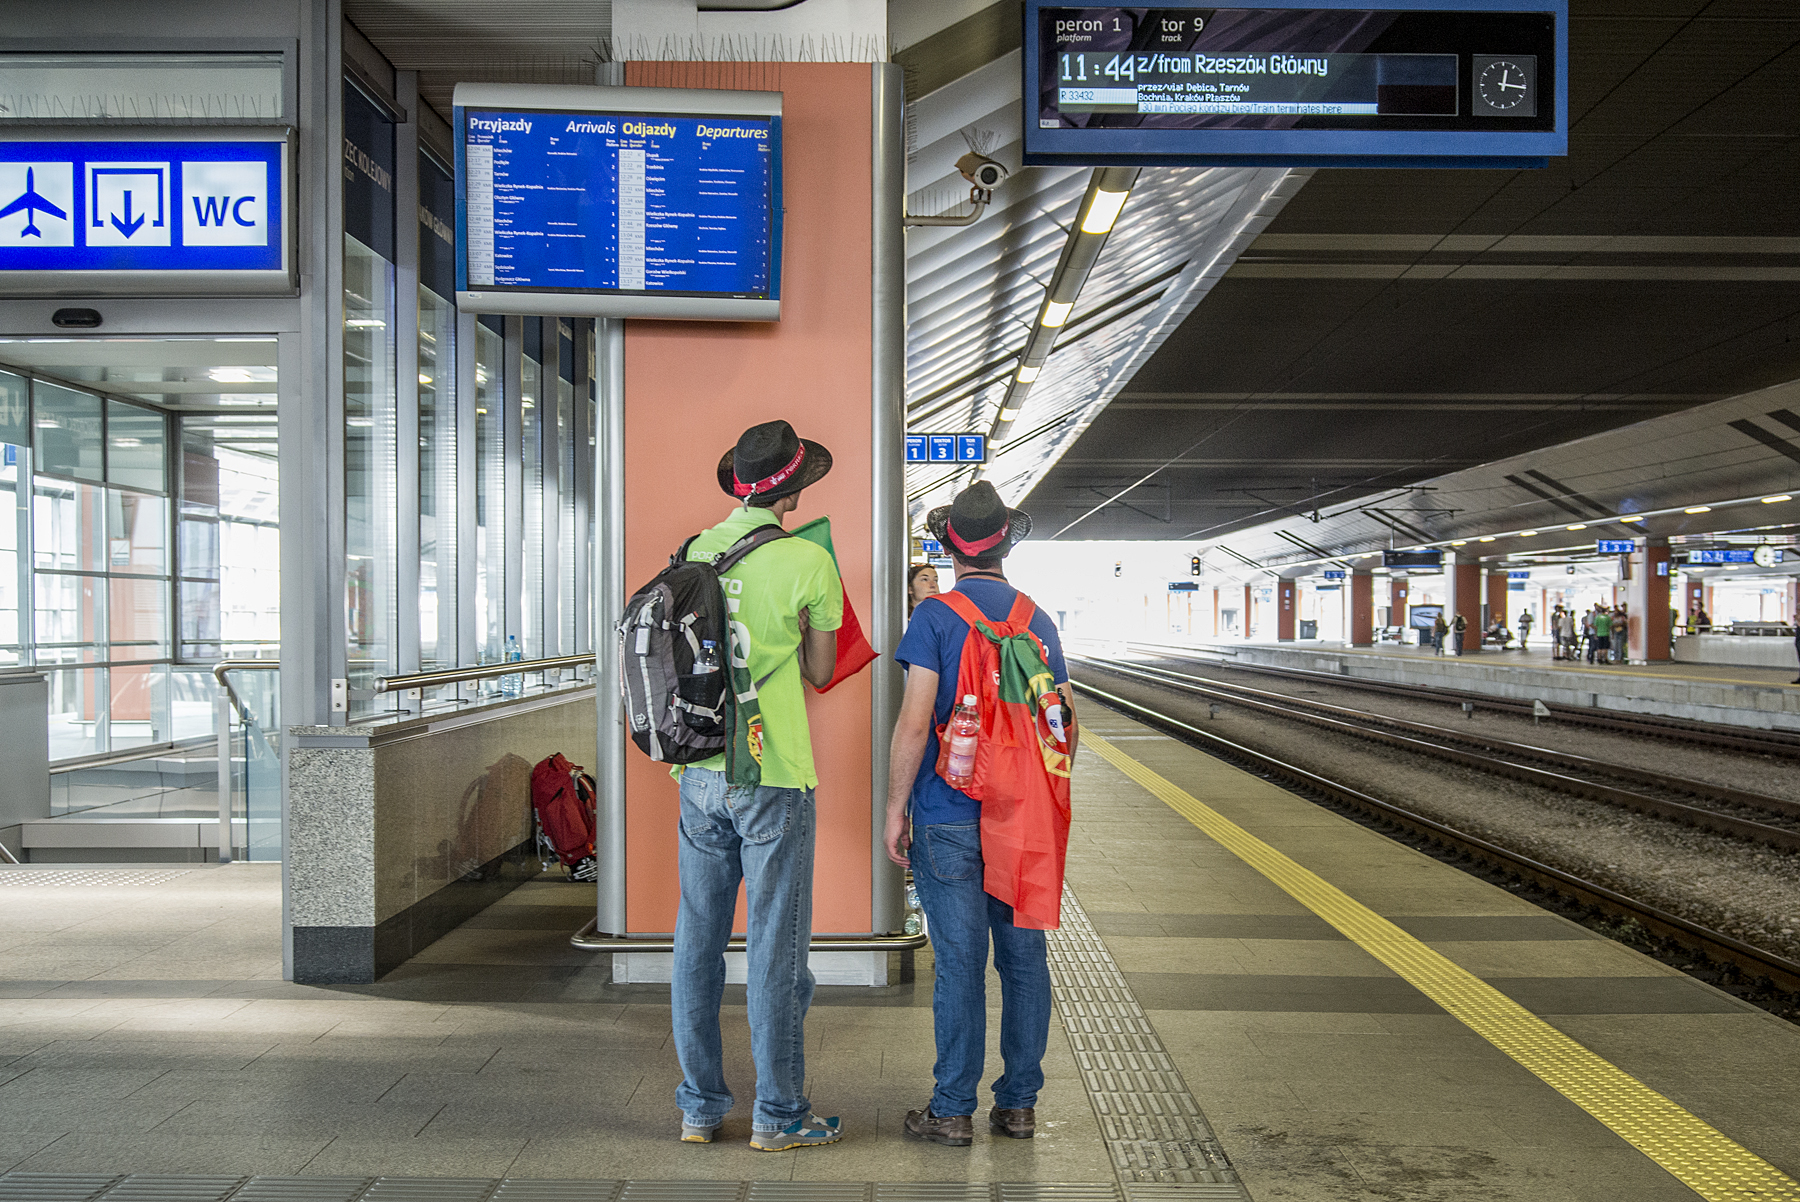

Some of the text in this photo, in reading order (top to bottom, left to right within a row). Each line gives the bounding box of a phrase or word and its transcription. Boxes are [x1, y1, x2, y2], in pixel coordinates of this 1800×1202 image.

[1056, 17, 1122, 34] peron 1
[1161, 17, 1204, 32] tor 9
[1056, 33, 1092, 43] platform
[1161, 34, 1183, 43] track
[1136, 53, 1328, 77] z/from Rzeszów Główny
[1218, 83, 1250, 92] Tarnów
[1061, 90, 1094, 101] R 33432
[1174, 93, 1204, 102] Kraków
[1205, 93, 1241, 102] Płaszów
[1277, 104, 1321, 114] terminates
[1322, 104, 1342, 114] here
[469, 117, 616, 134] Przyjazdy Arrivals
[622, 122, 768, 140] Odjazdy Departures
[192, 195, 257, 228] WC
[911, 448, 975, 459] 1 3 9
[1613, 544, 1620, 552] 3
[1625, 544, 1632, 552] 2
